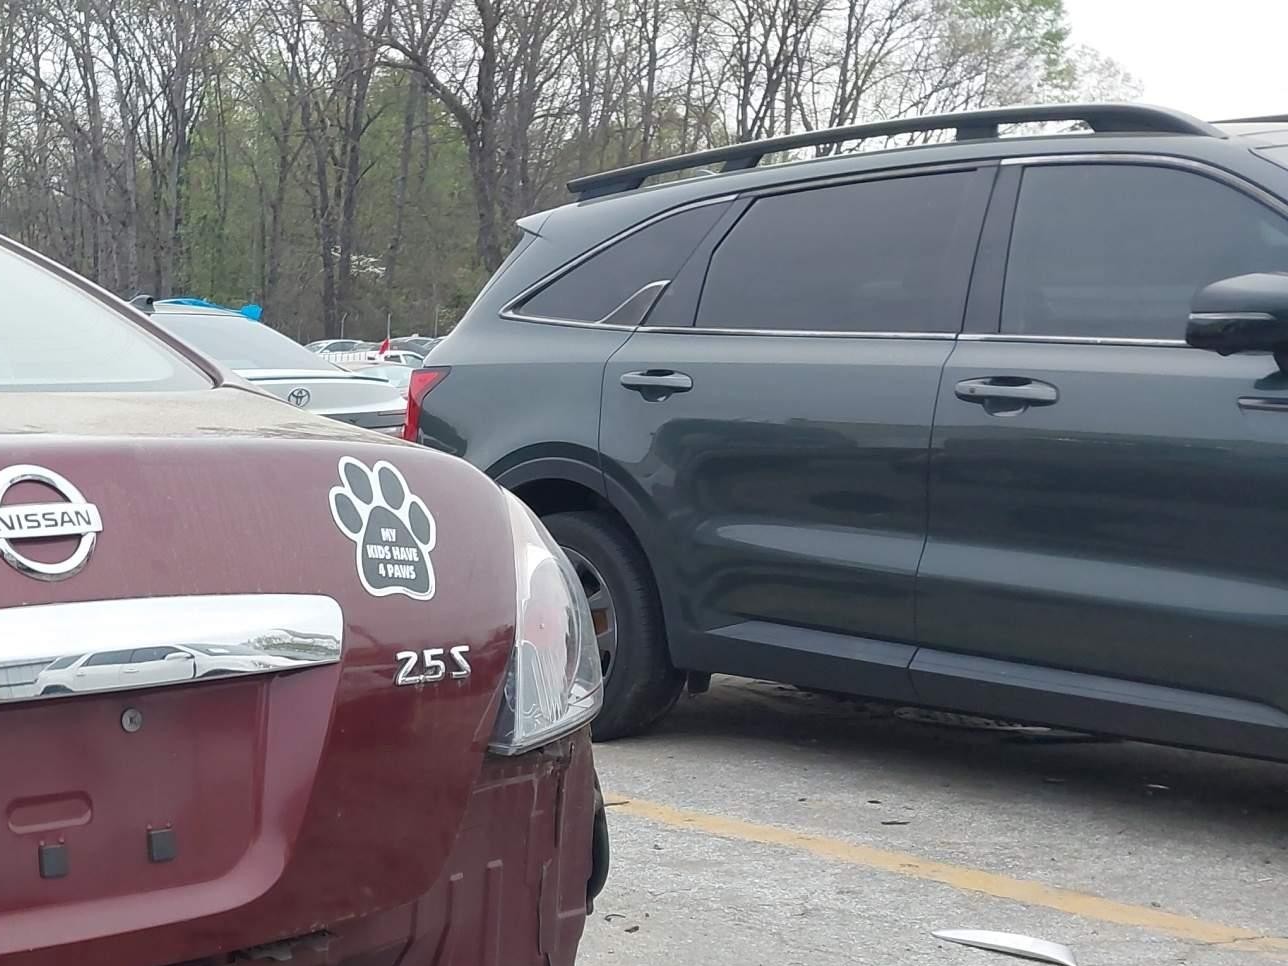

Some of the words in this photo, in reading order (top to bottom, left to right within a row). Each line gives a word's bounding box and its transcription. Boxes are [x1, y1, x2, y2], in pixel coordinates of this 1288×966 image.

[380, 527, 397, 542] MY
[366, 544, 392, 560] KIDS
[391, 546, 420, 562] HAVE
[378, 563, 386, 577] 4
[386, 563, 417, 580] PAWS
